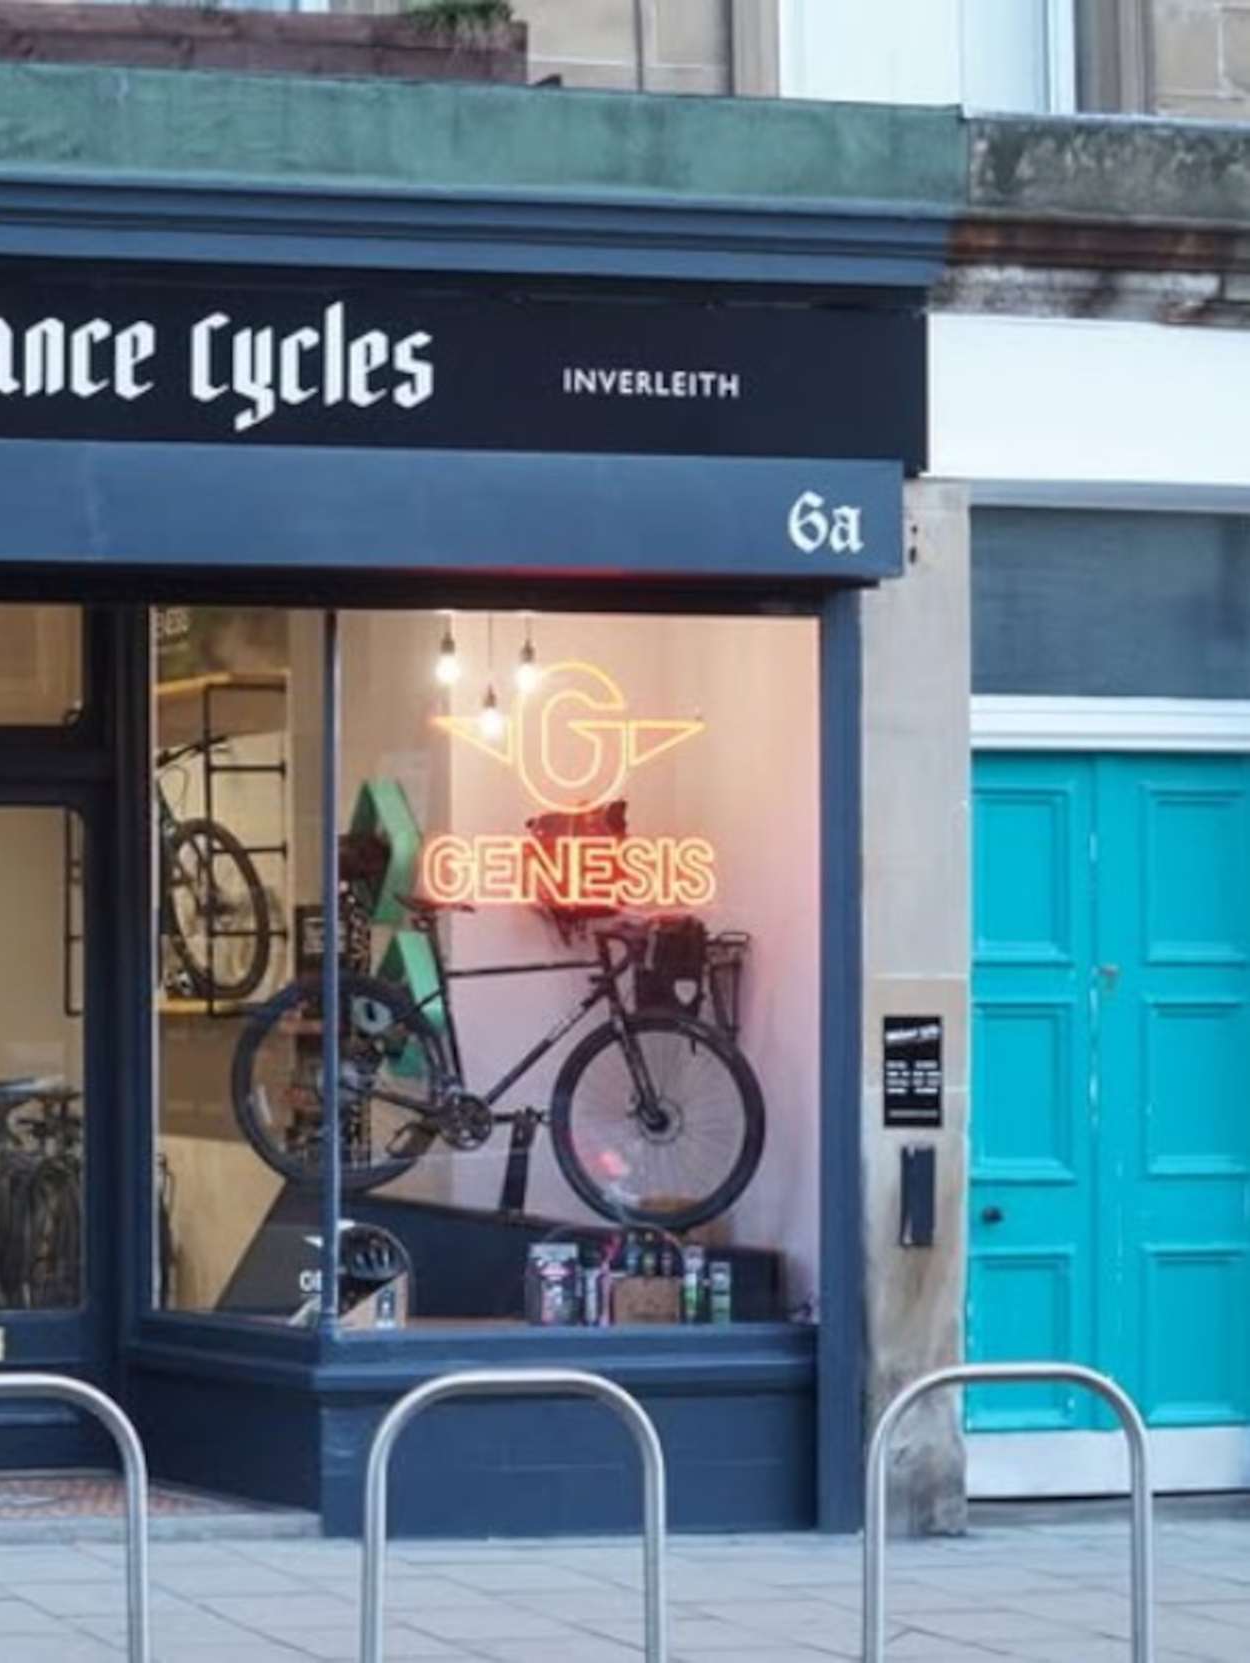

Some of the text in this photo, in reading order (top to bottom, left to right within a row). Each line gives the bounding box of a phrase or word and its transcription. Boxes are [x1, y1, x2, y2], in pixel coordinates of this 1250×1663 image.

[191, 300, 434, 432] Cycles
[562, 367, 741, 398] INVERLEITH
[787, 490, 865, 554] 6a
[422, 835, 716, 906] GENESIS
